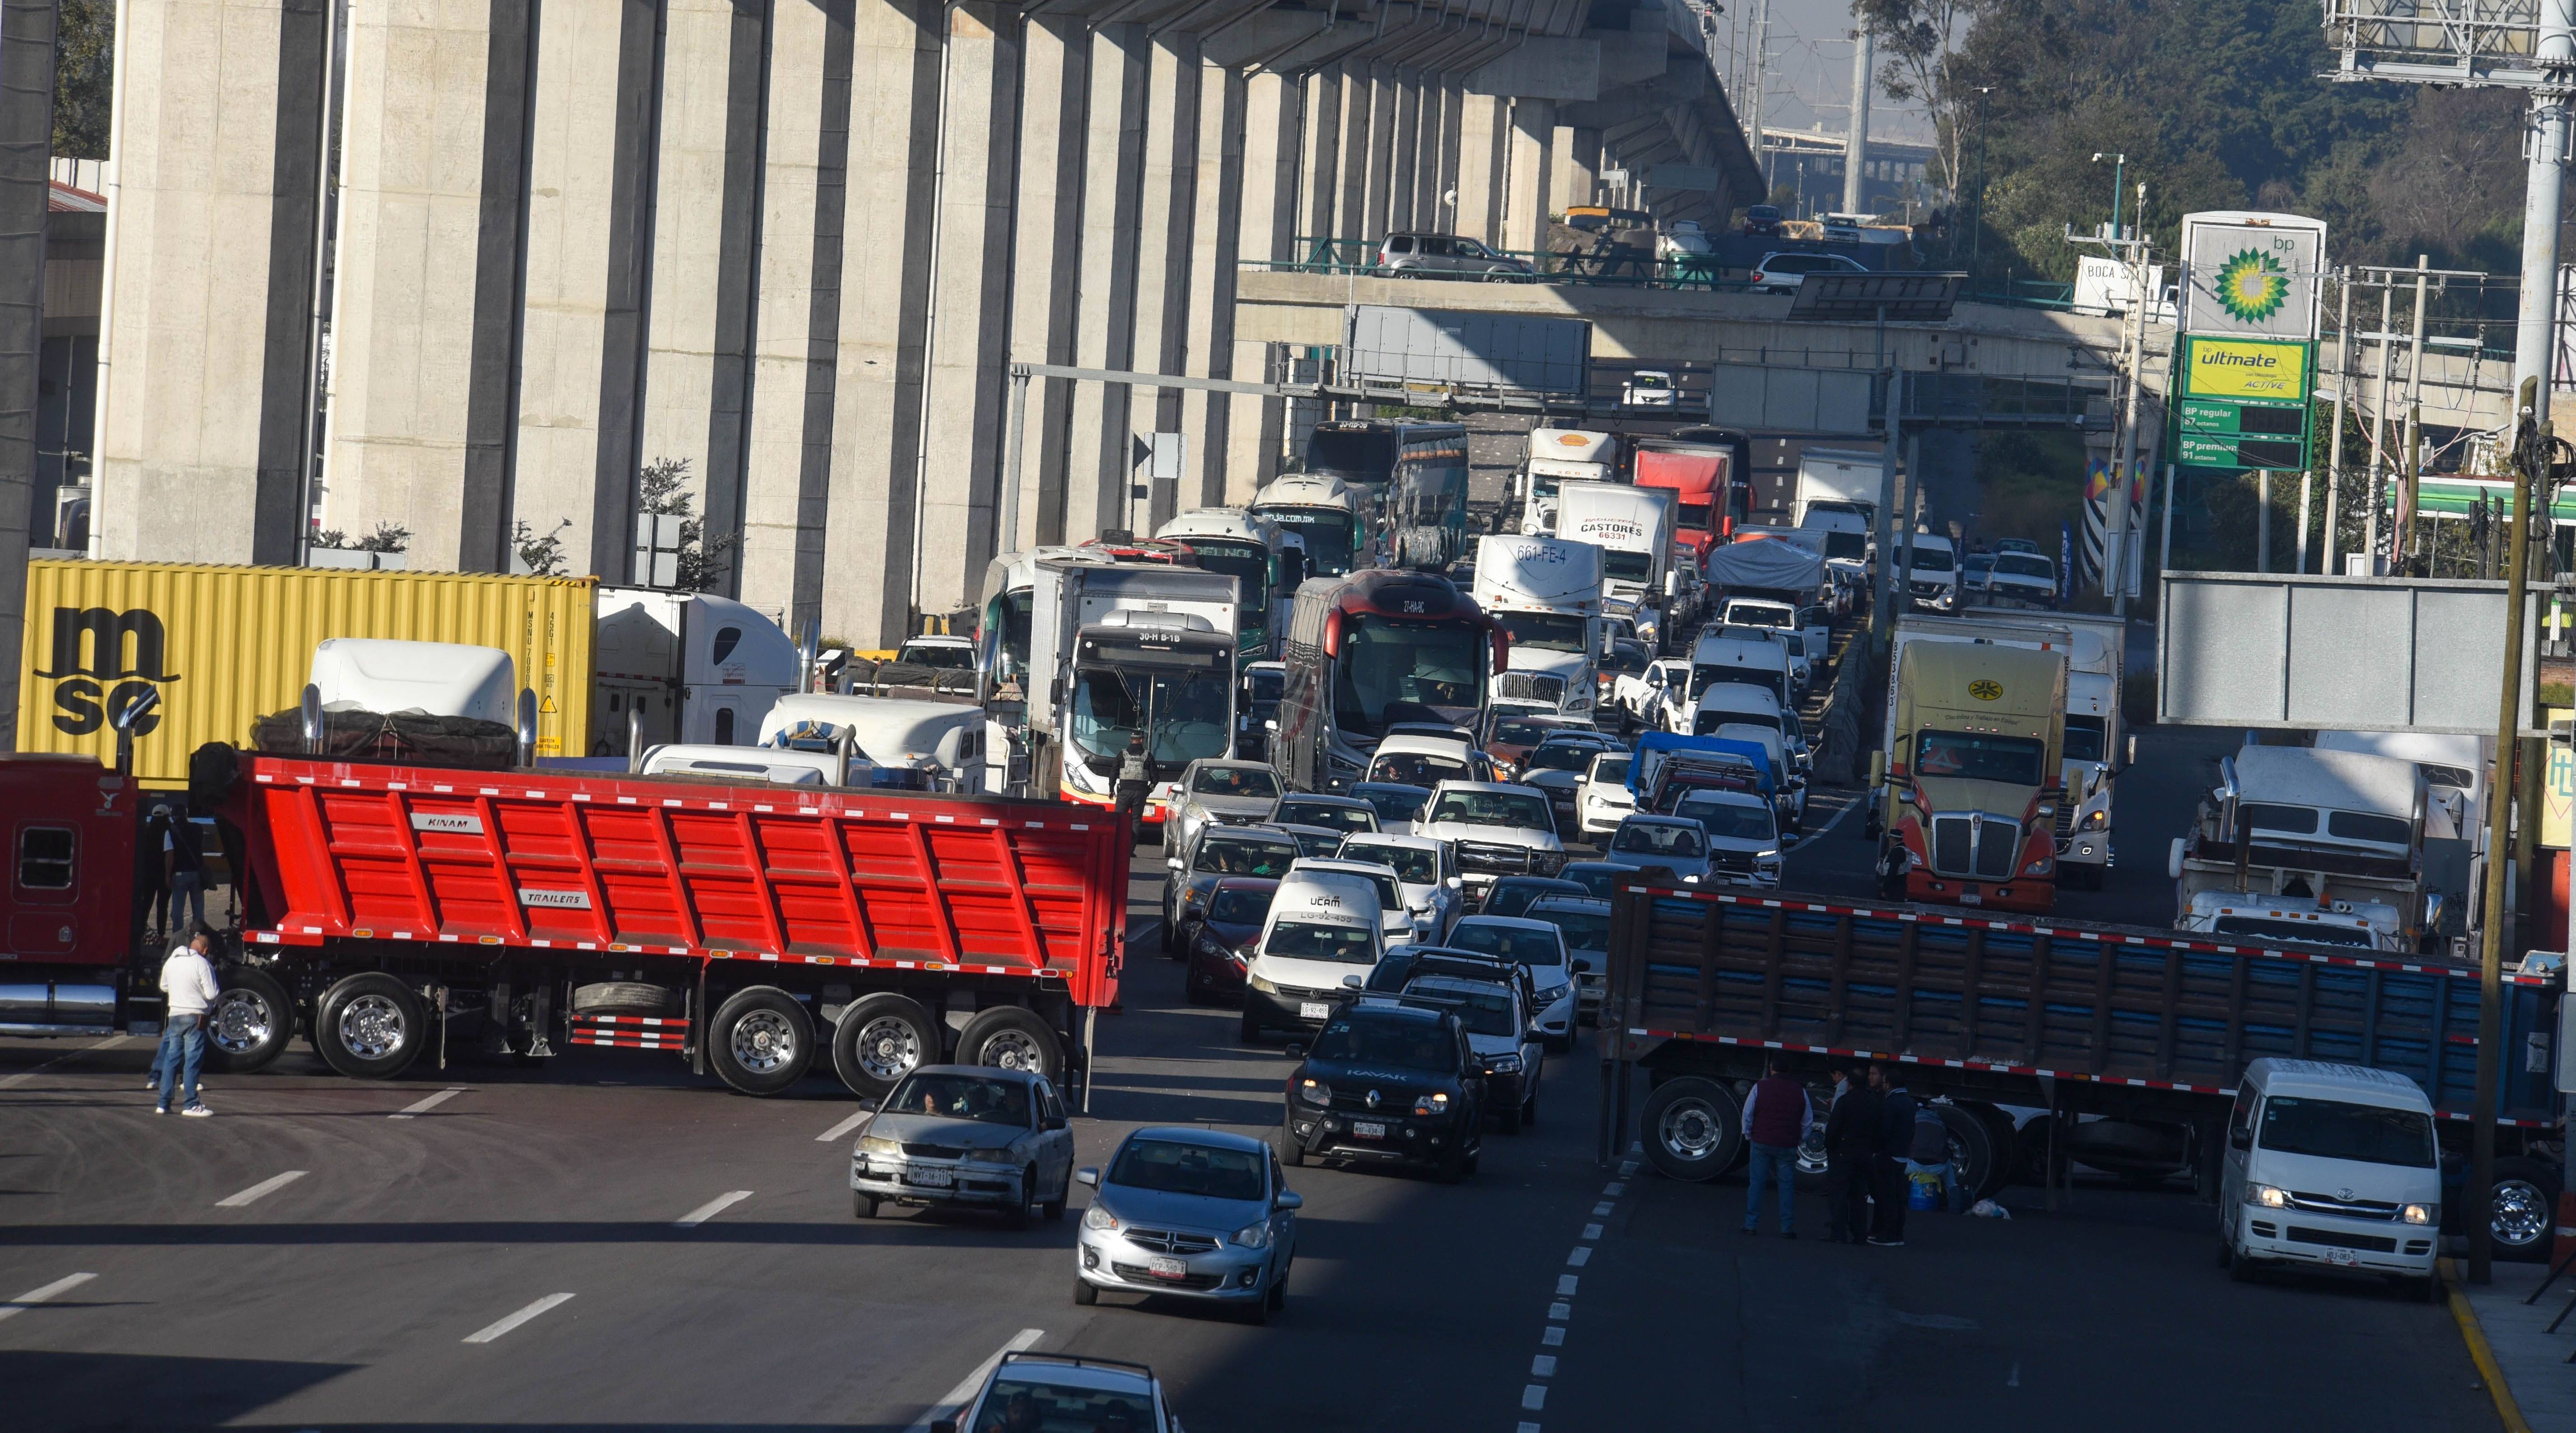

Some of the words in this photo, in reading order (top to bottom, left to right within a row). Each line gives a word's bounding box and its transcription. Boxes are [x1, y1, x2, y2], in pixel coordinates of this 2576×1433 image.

[2274, 235, 2295, 253] bp
[2088, 266, 2114, 278] BOCA
[2203, 345, 2212, 354] bp
[2202, 351, 2277, 368] ultimate
[2244, 381, 2286, 390] ACTIVE
[2200, 410, 2231, 418] regular
[2184, 417, 2195, 425] 87
[2197, 443, 2237, 453] premium
[1581, 523, 1642, 536] CASTORES
[1599, 532, 1626, 541] 66331
[1518, 545, 1566, 565] 661-FE-4
[1890, 642, 1898, 706] 853863
[428, 819, 468, 828] KINAM
[528, 894, 580, 904] TRAILERS
[1311, 898, 1340, 908] UCAM
[1301, 912, 1352, 923] LG-92-455
[1347, 1069, 1407, 1082] KAVAK
[914, 1171, 945, 1181] NVT-16-11
